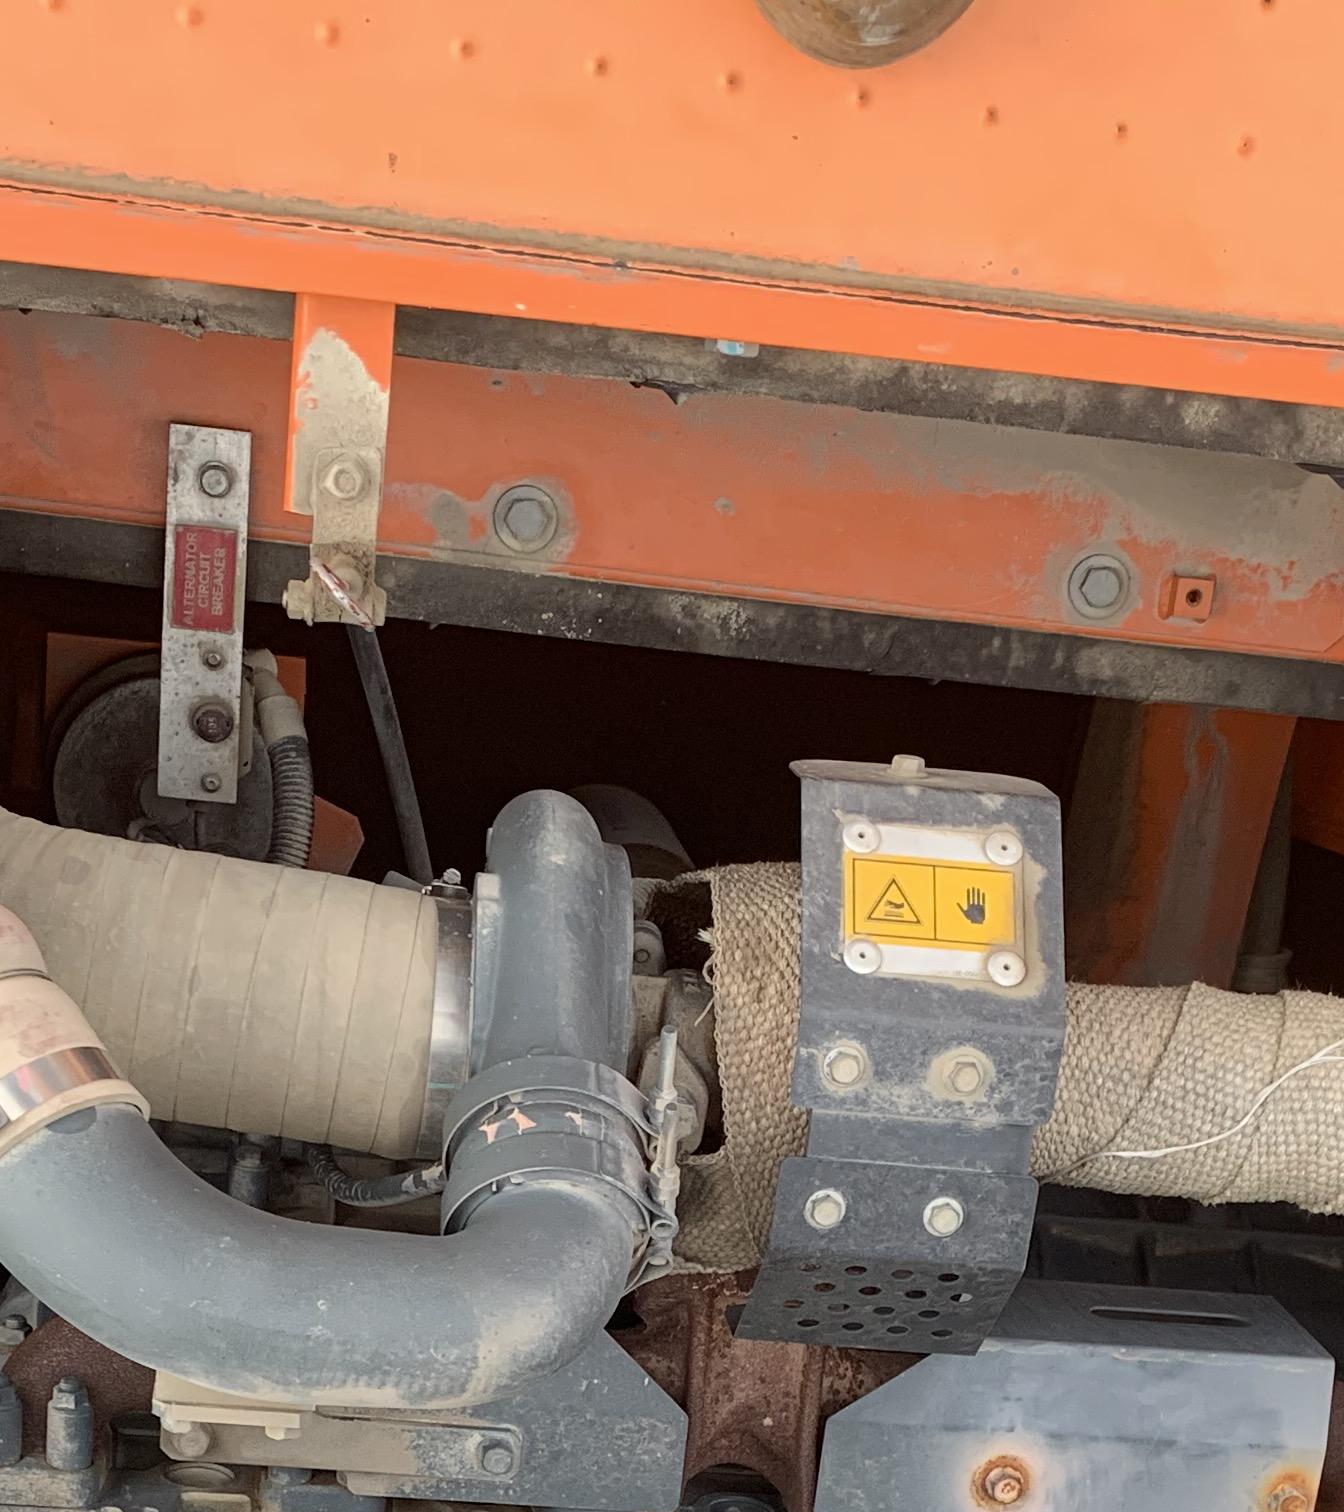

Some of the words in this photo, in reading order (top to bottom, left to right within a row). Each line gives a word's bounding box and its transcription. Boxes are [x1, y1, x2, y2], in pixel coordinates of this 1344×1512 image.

[184, 531, 198, 625] ALTERNATOR
[198, 553, 211, 608] CIRCUIT
[211, 547, 226, 616] BREAKER
